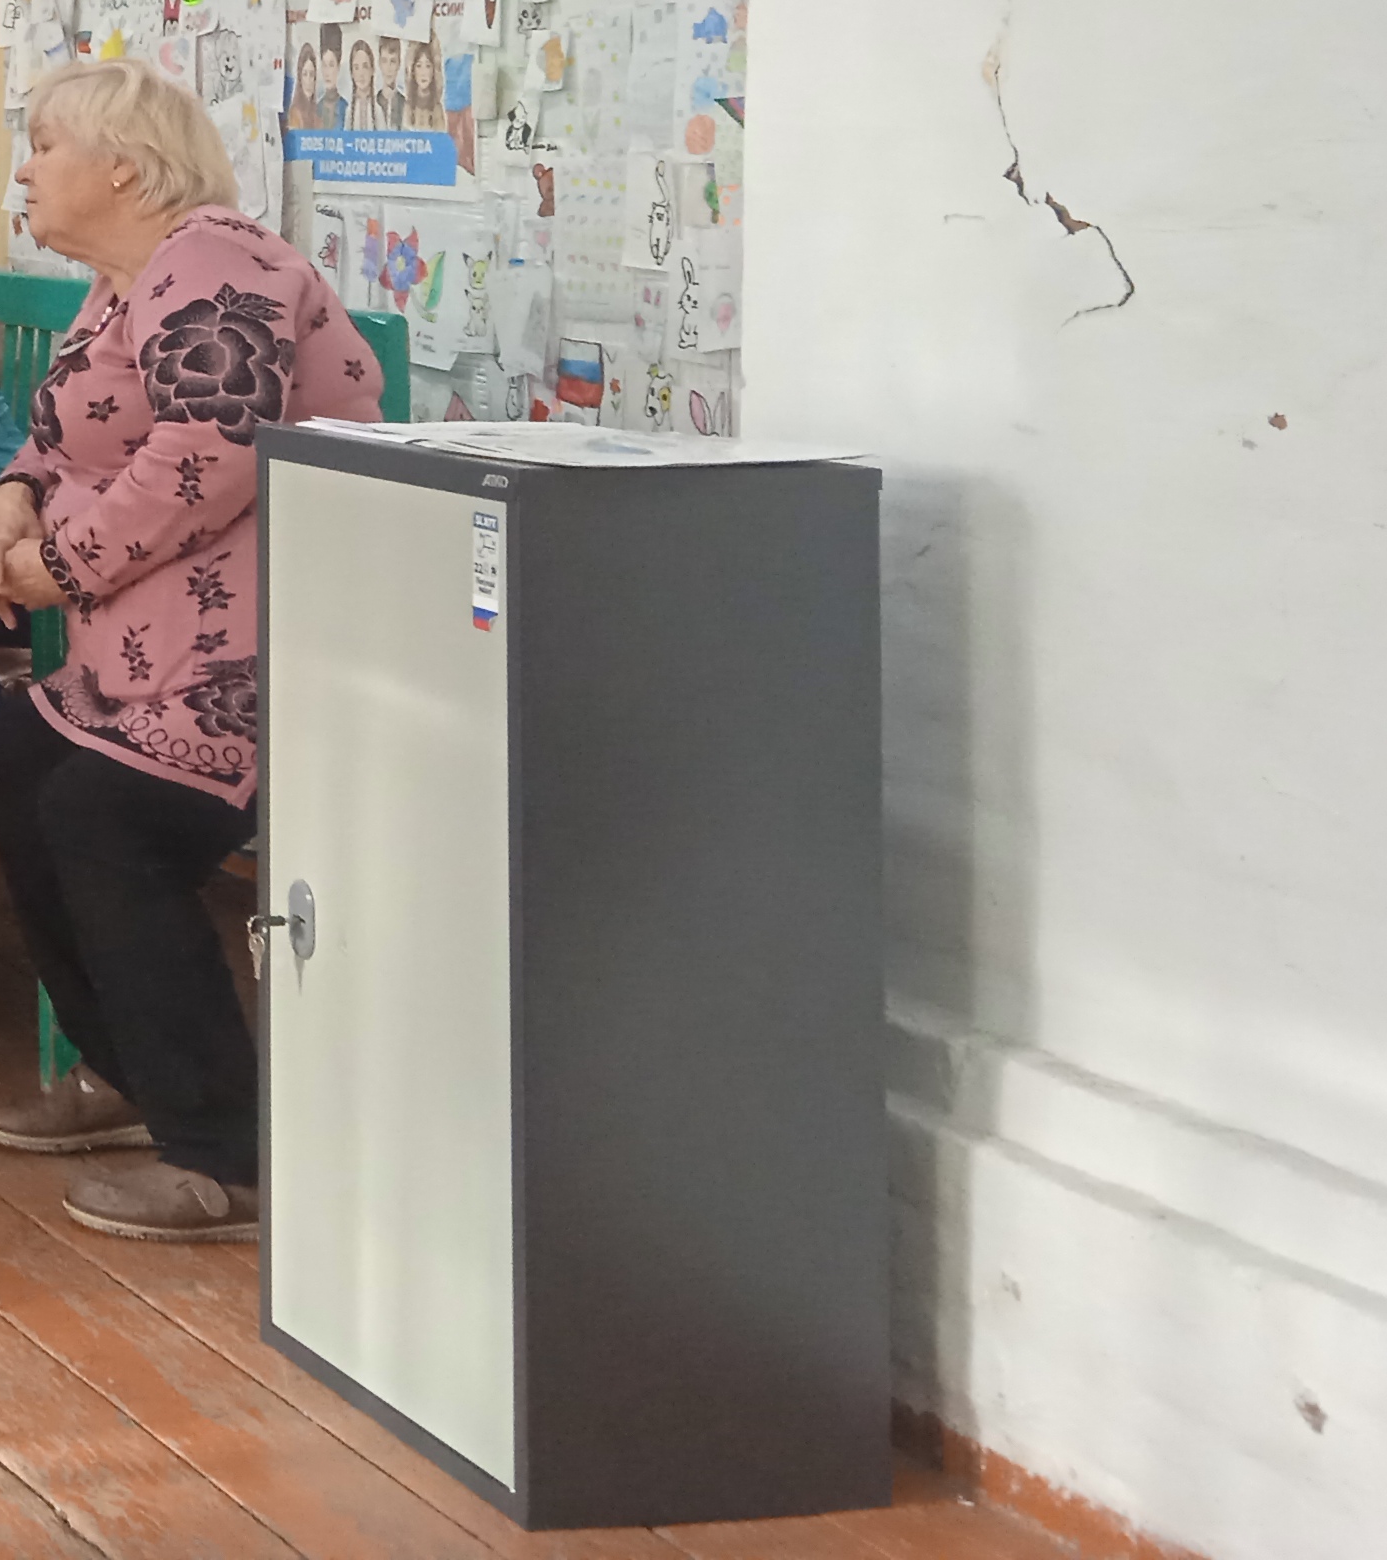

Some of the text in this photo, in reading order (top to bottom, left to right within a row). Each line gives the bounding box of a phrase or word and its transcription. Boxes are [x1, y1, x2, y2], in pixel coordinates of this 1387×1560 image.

[324, 137, 345, 155] ГОД
[354, 138, 377, 155] ГОД
[377, 139, 432, 156] ЕДИНСТВА
[319, 160, 408, 177] НАРОДОВ РОССИИ
